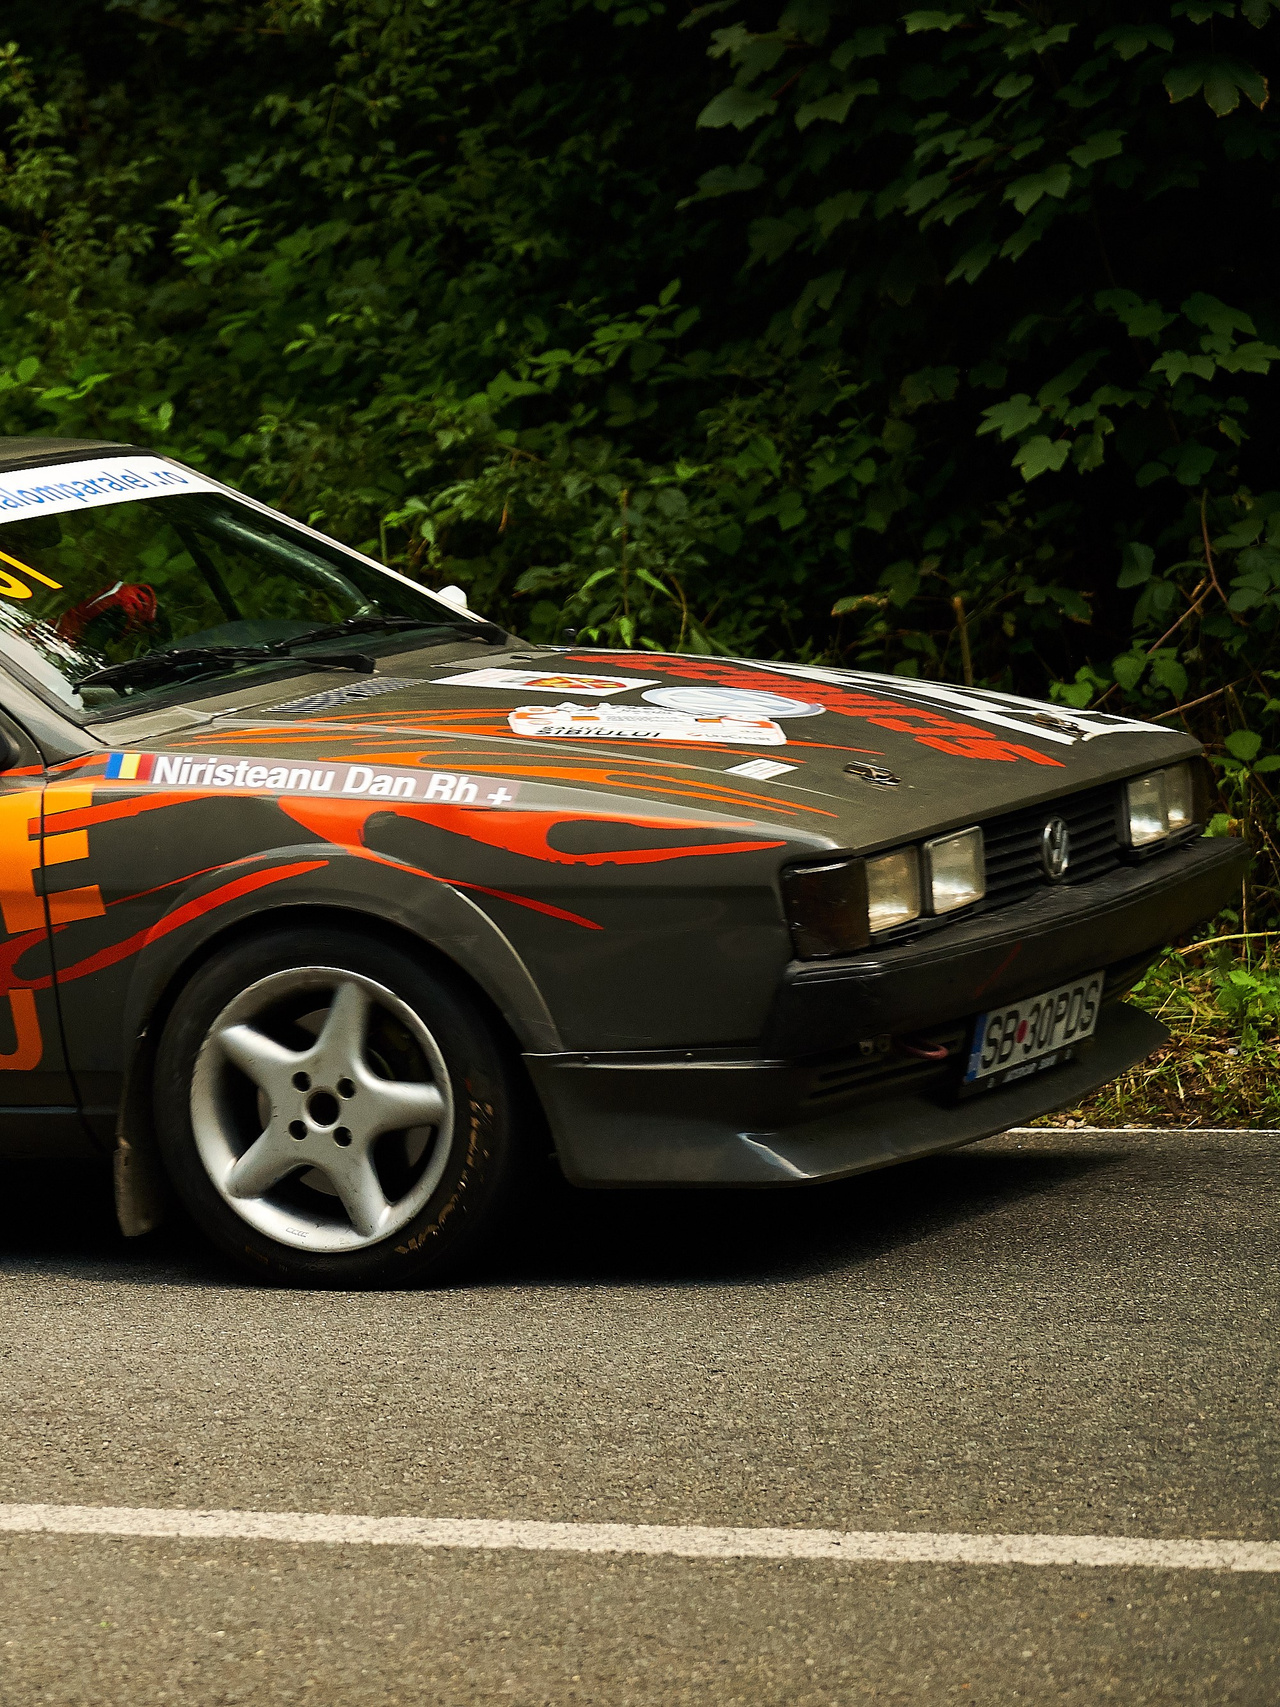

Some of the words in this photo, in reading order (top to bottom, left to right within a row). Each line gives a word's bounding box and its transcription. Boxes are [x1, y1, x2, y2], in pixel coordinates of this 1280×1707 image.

[152, 755, 335, 791] Niristeanu
[341, 766, 416, 797] Dan
[423, 773, 479, 802] Rh
